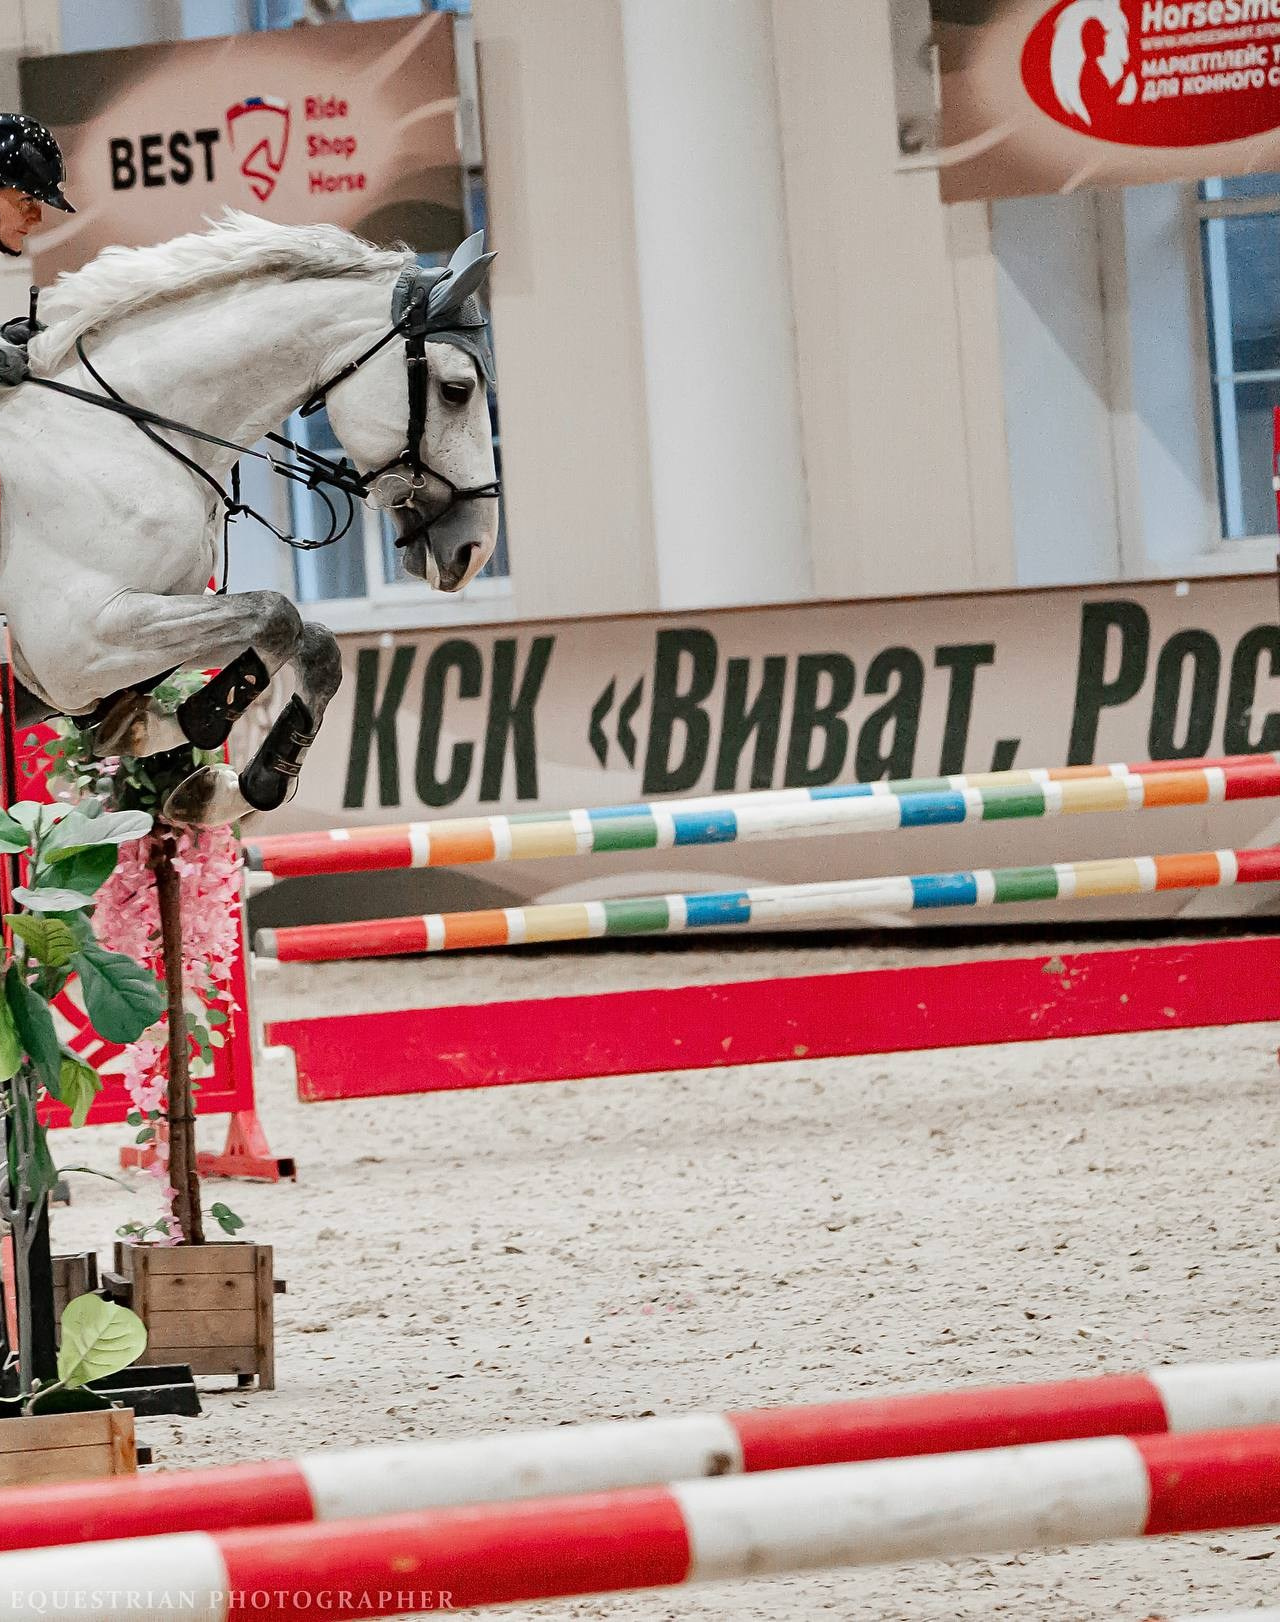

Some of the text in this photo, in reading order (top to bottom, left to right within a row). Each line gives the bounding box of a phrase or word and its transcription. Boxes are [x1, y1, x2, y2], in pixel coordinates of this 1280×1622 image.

[1141, 77, 1180, 104] ДЛЯ
[1182, 68, 1265, 95] КОННОГО
[304, 95, 348, 121] Ride
[108, 127, 220, 191] BEST
[306, 133, 357, 160] Shop
[308, 169, 367, 194] Horse
[343, 635, 556, 809] КСК
